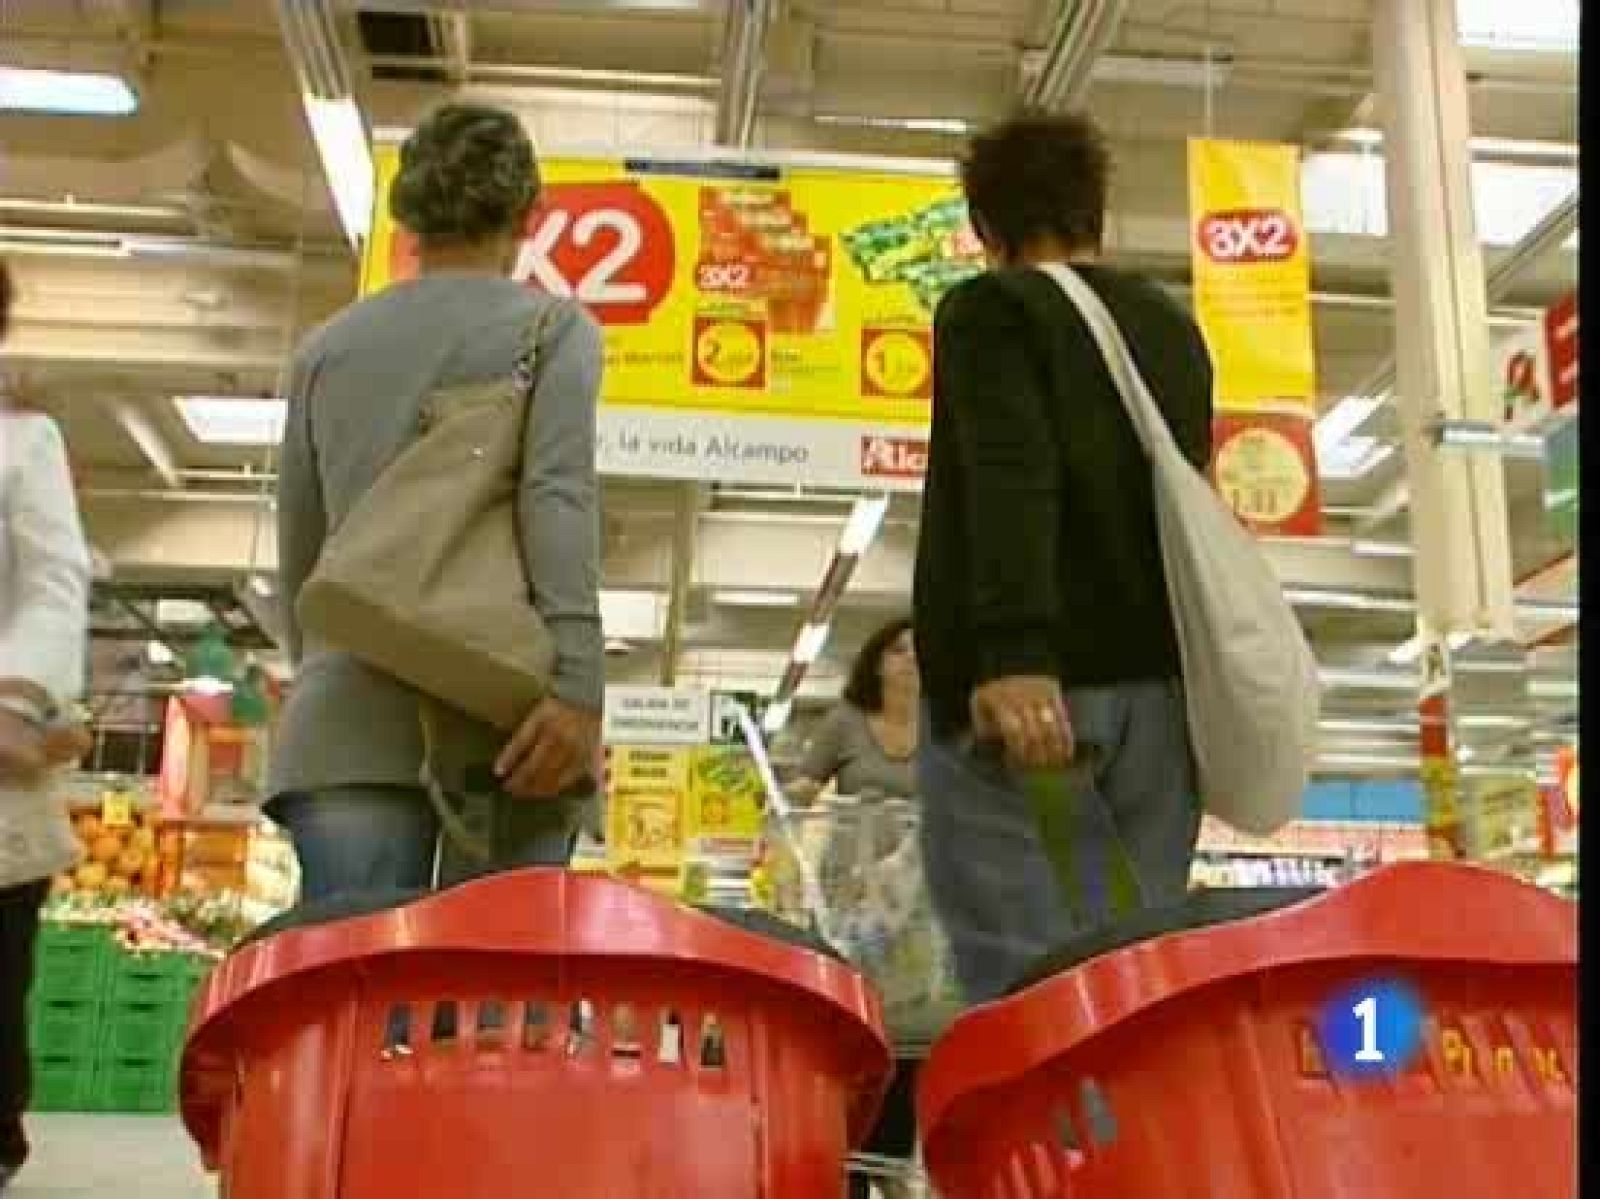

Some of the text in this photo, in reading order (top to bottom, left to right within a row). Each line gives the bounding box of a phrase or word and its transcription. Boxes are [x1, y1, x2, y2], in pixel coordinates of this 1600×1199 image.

[1208, 215, 1296, 258] 3X2
[619, 429, 641, 452] la
[650, 431, 697, 456] vida
[706, 434, 810, 465] Alcampo
